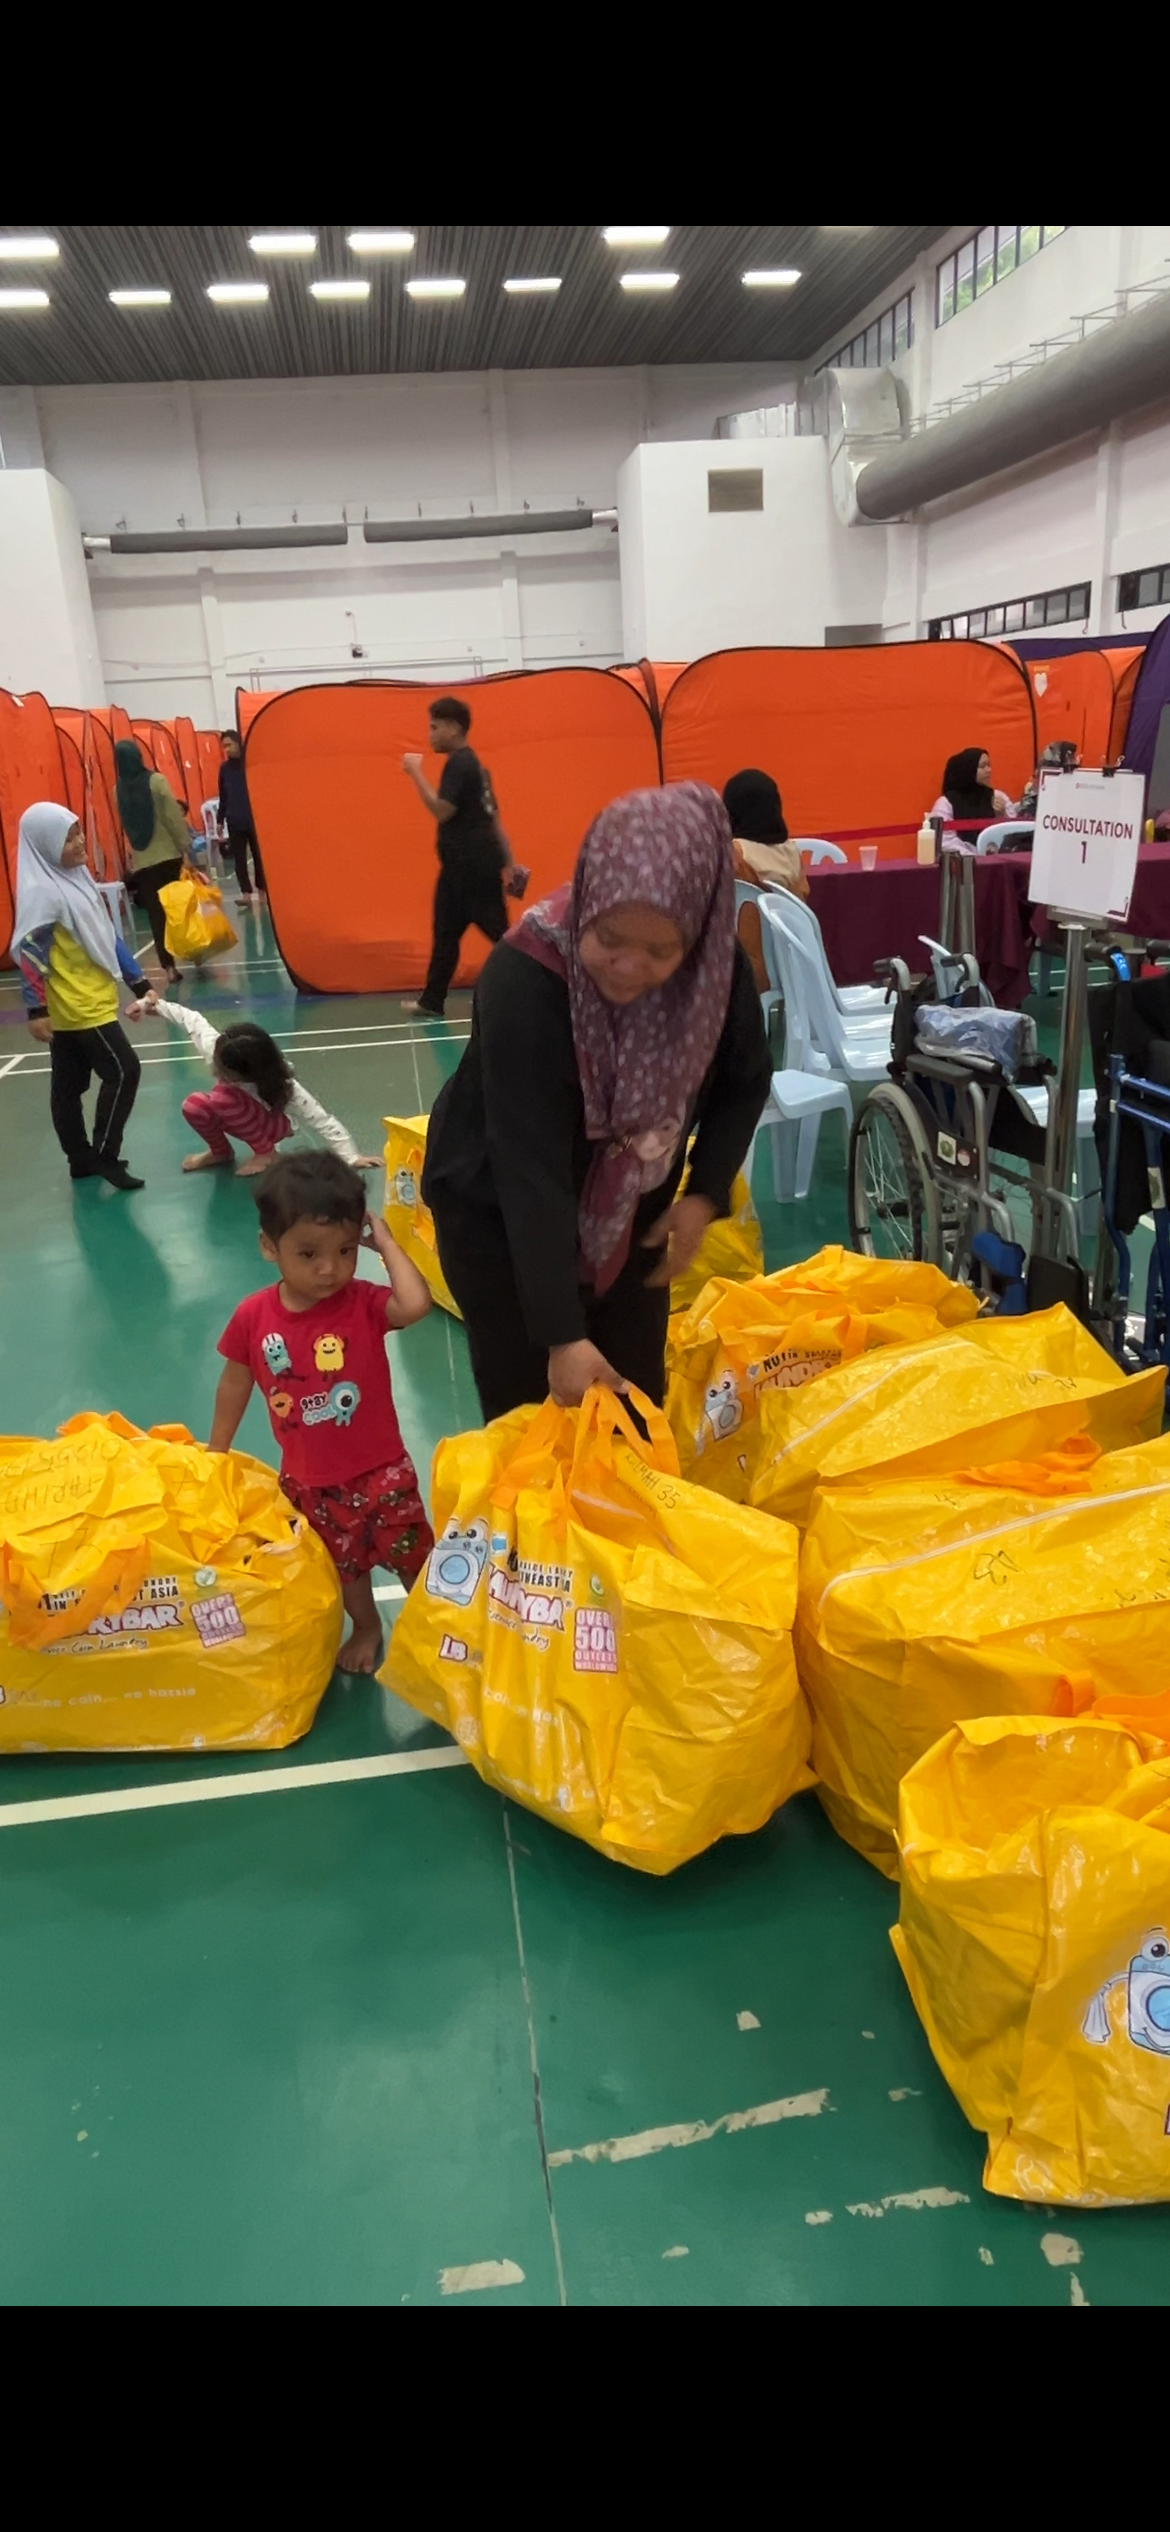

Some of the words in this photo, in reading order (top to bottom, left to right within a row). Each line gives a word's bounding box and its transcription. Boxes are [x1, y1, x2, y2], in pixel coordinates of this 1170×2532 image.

[1043, 814, 1133, 840] CONSULTATION
[1080, 841, 1087, 864] 1
[657, 1479, 681, 1511] 35
[150, 1585, 179, 1599] ASIA
[195, 1606, 239, 1631] 500
[439, 1633, 468, 1662] LB
[575, 1625, 616, 1652] 500
